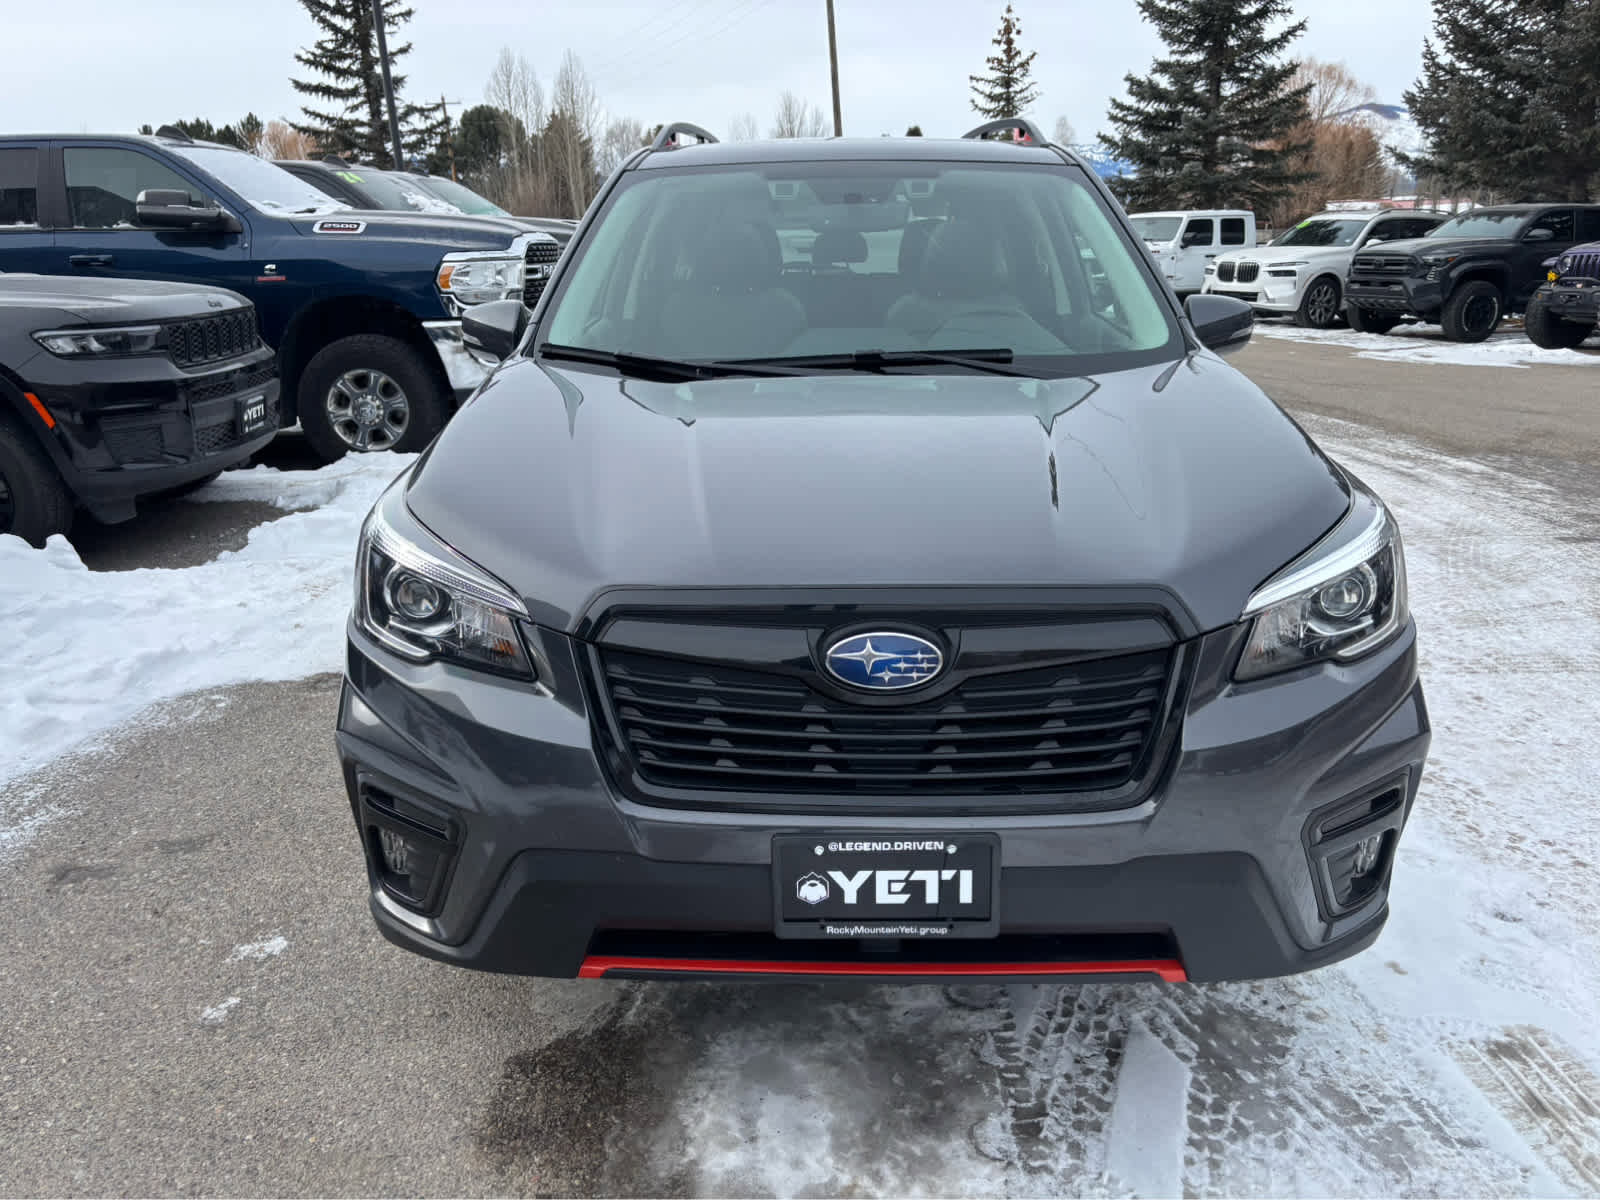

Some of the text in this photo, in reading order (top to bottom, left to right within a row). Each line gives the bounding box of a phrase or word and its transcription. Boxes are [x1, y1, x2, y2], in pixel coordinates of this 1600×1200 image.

[247, 403, 264, 420] YETI
[828, 841, 944, 851] @LEGEND.DRIVEN
[827, 869, 973, 904] YETI
[826, 925, 948, 936] RockyMountainYeti.group
